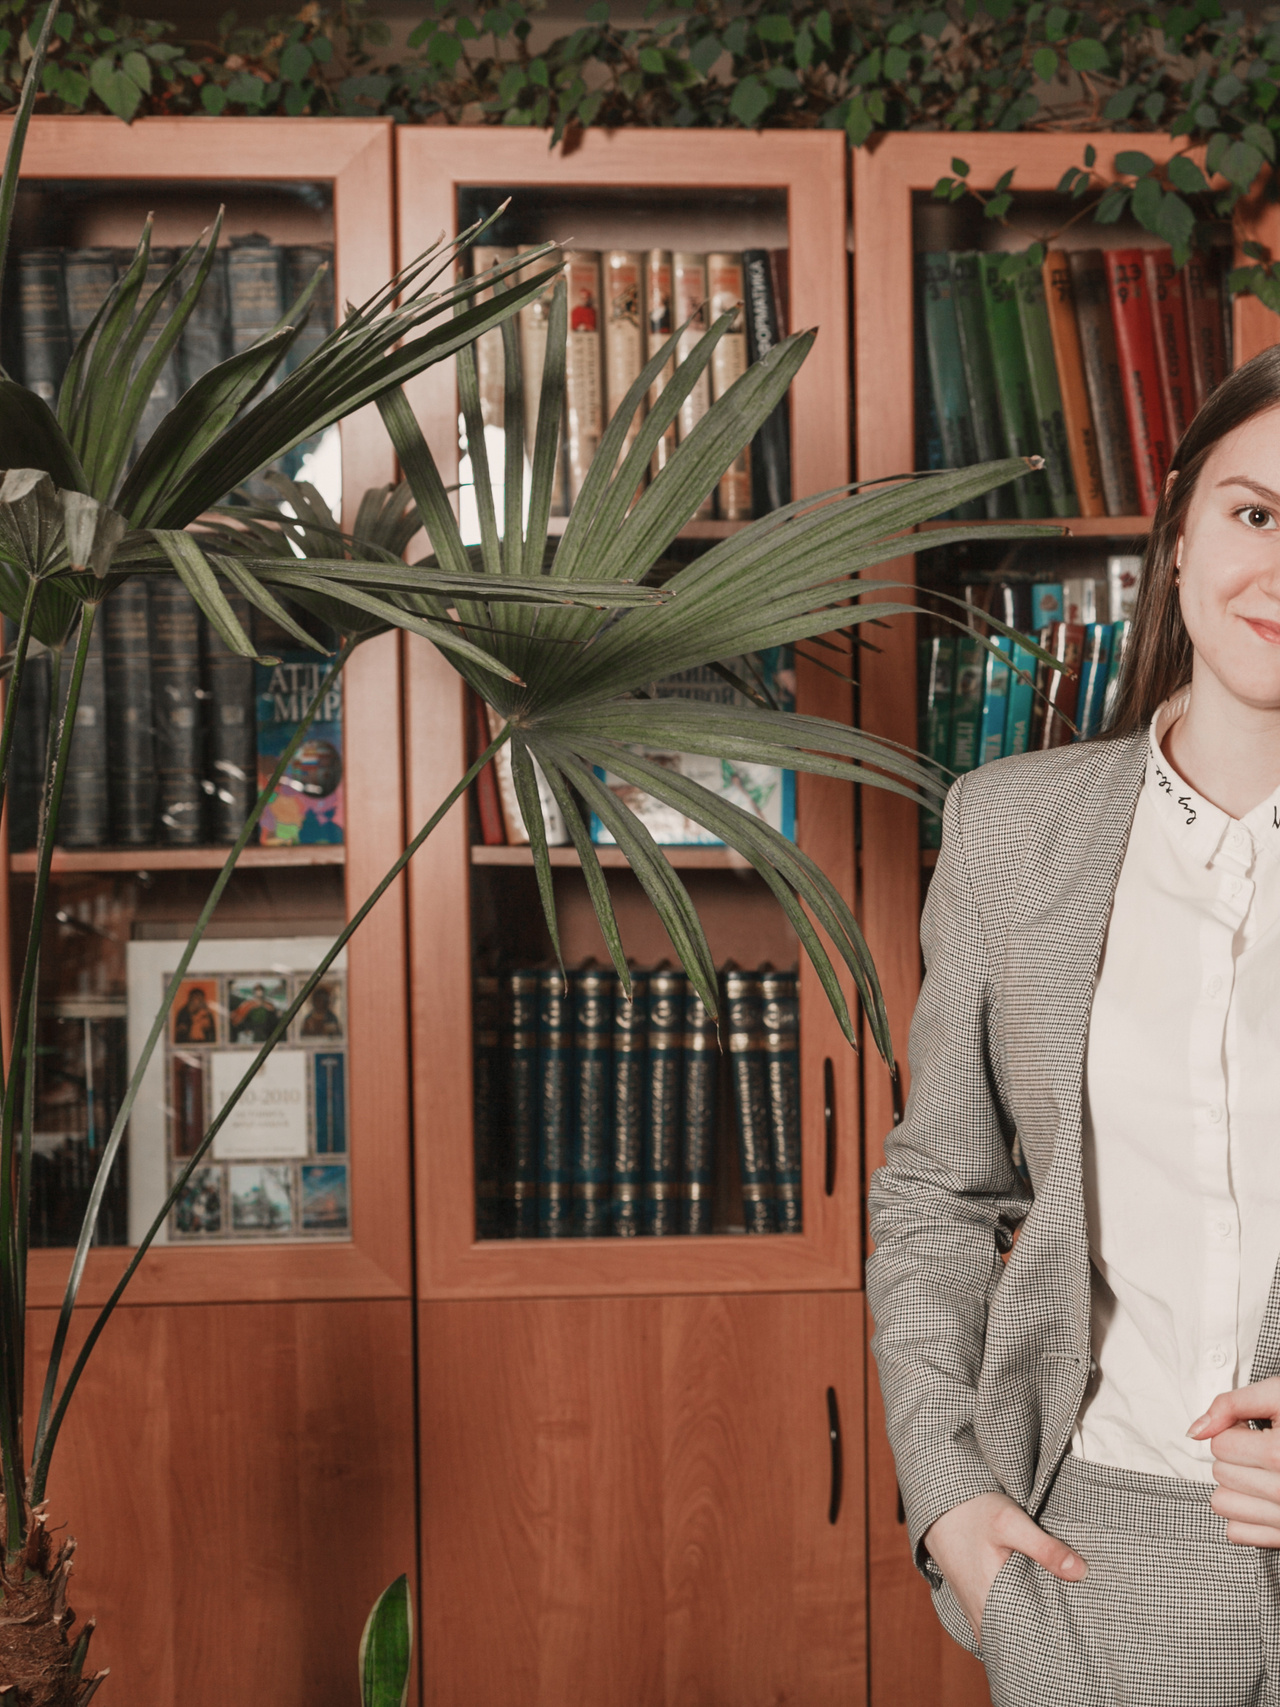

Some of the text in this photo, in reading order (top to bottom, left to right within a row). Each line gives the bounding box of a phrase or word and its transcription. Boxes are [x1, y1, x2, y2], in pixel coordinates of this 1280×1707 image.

[749, 259, 772, 356] ФОРМАТИКА
[268, 662, 342, 693] АТЛА
[274, 692, 342, 722] МИР
